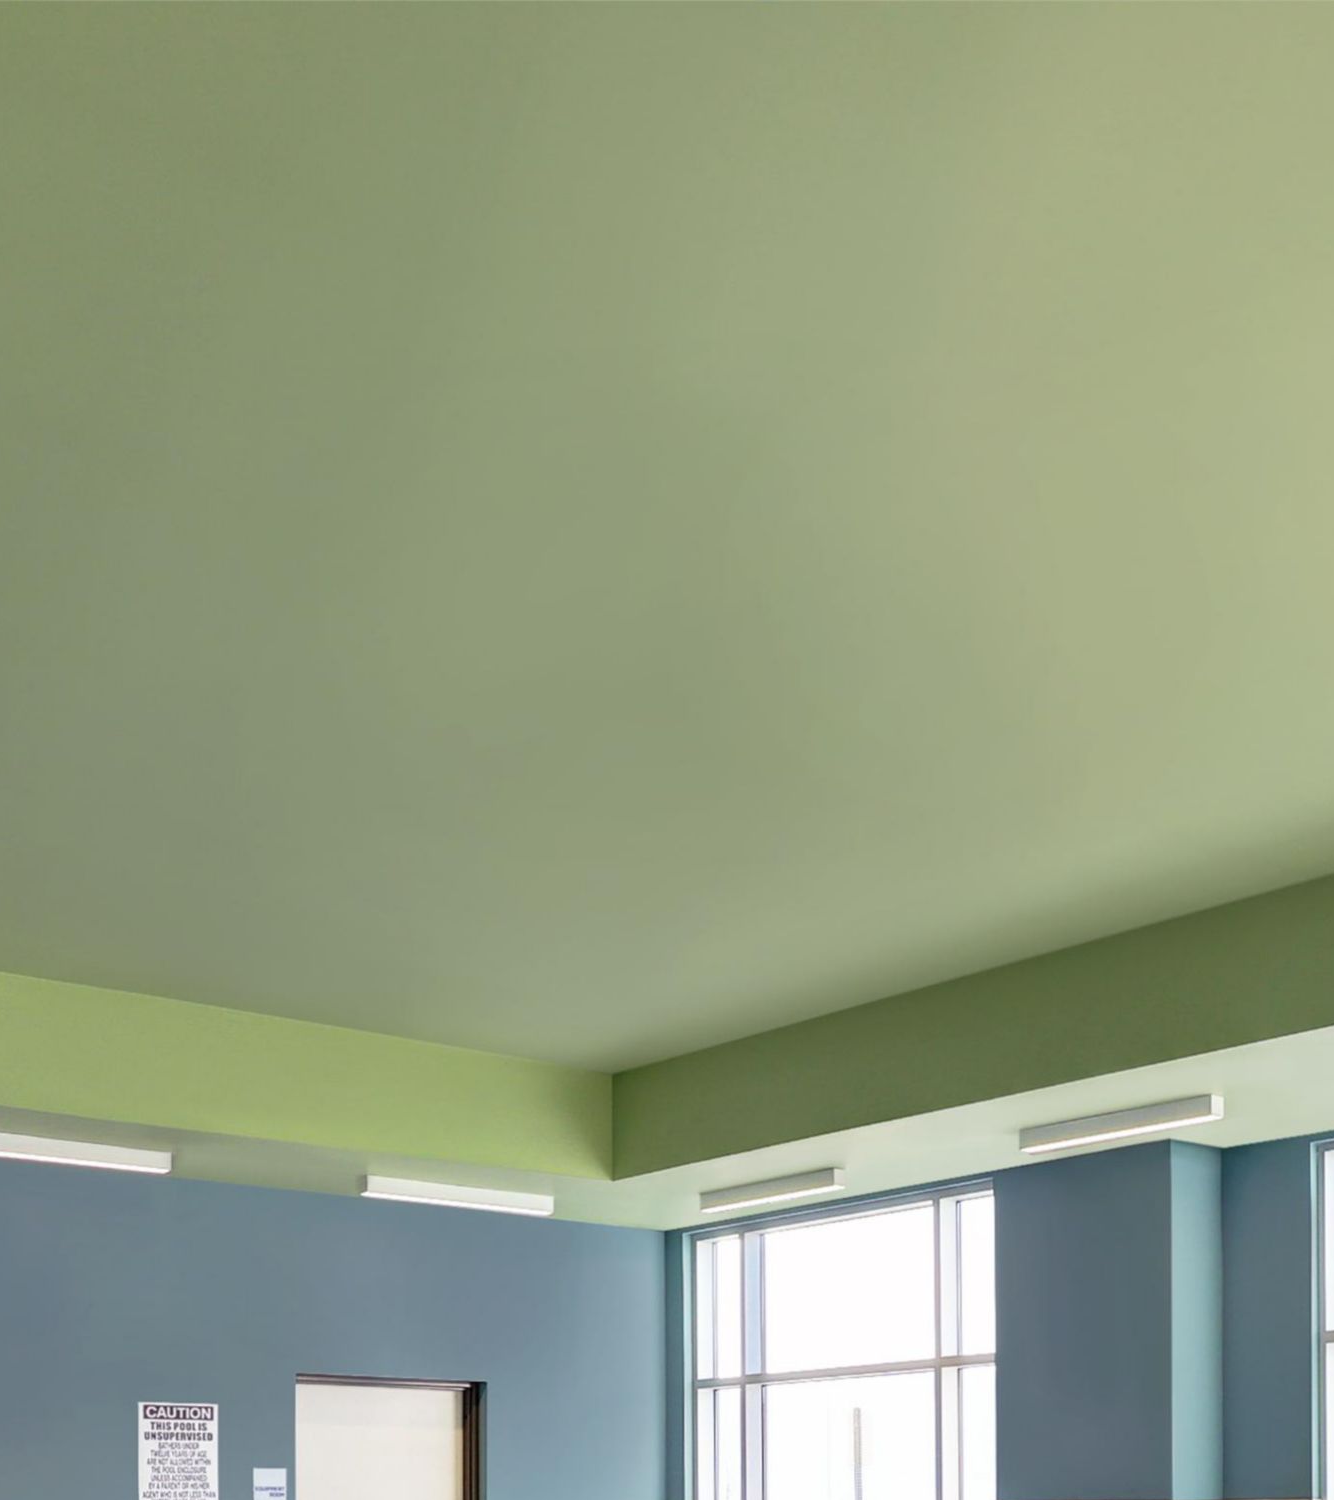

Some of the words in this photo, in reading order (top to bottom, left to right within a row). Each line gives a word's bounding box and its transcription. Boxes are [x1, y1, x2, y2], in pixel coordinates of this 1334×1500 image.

[145, 1406, 212, 1419] CAUTION
[150, 1422, 172, 1431] THIS
[174, 1422, 197, 1431] POOL
[198, 1423, 208, 1431] IS
[144, 1432, 213, 1441] UNSUPERVISED
